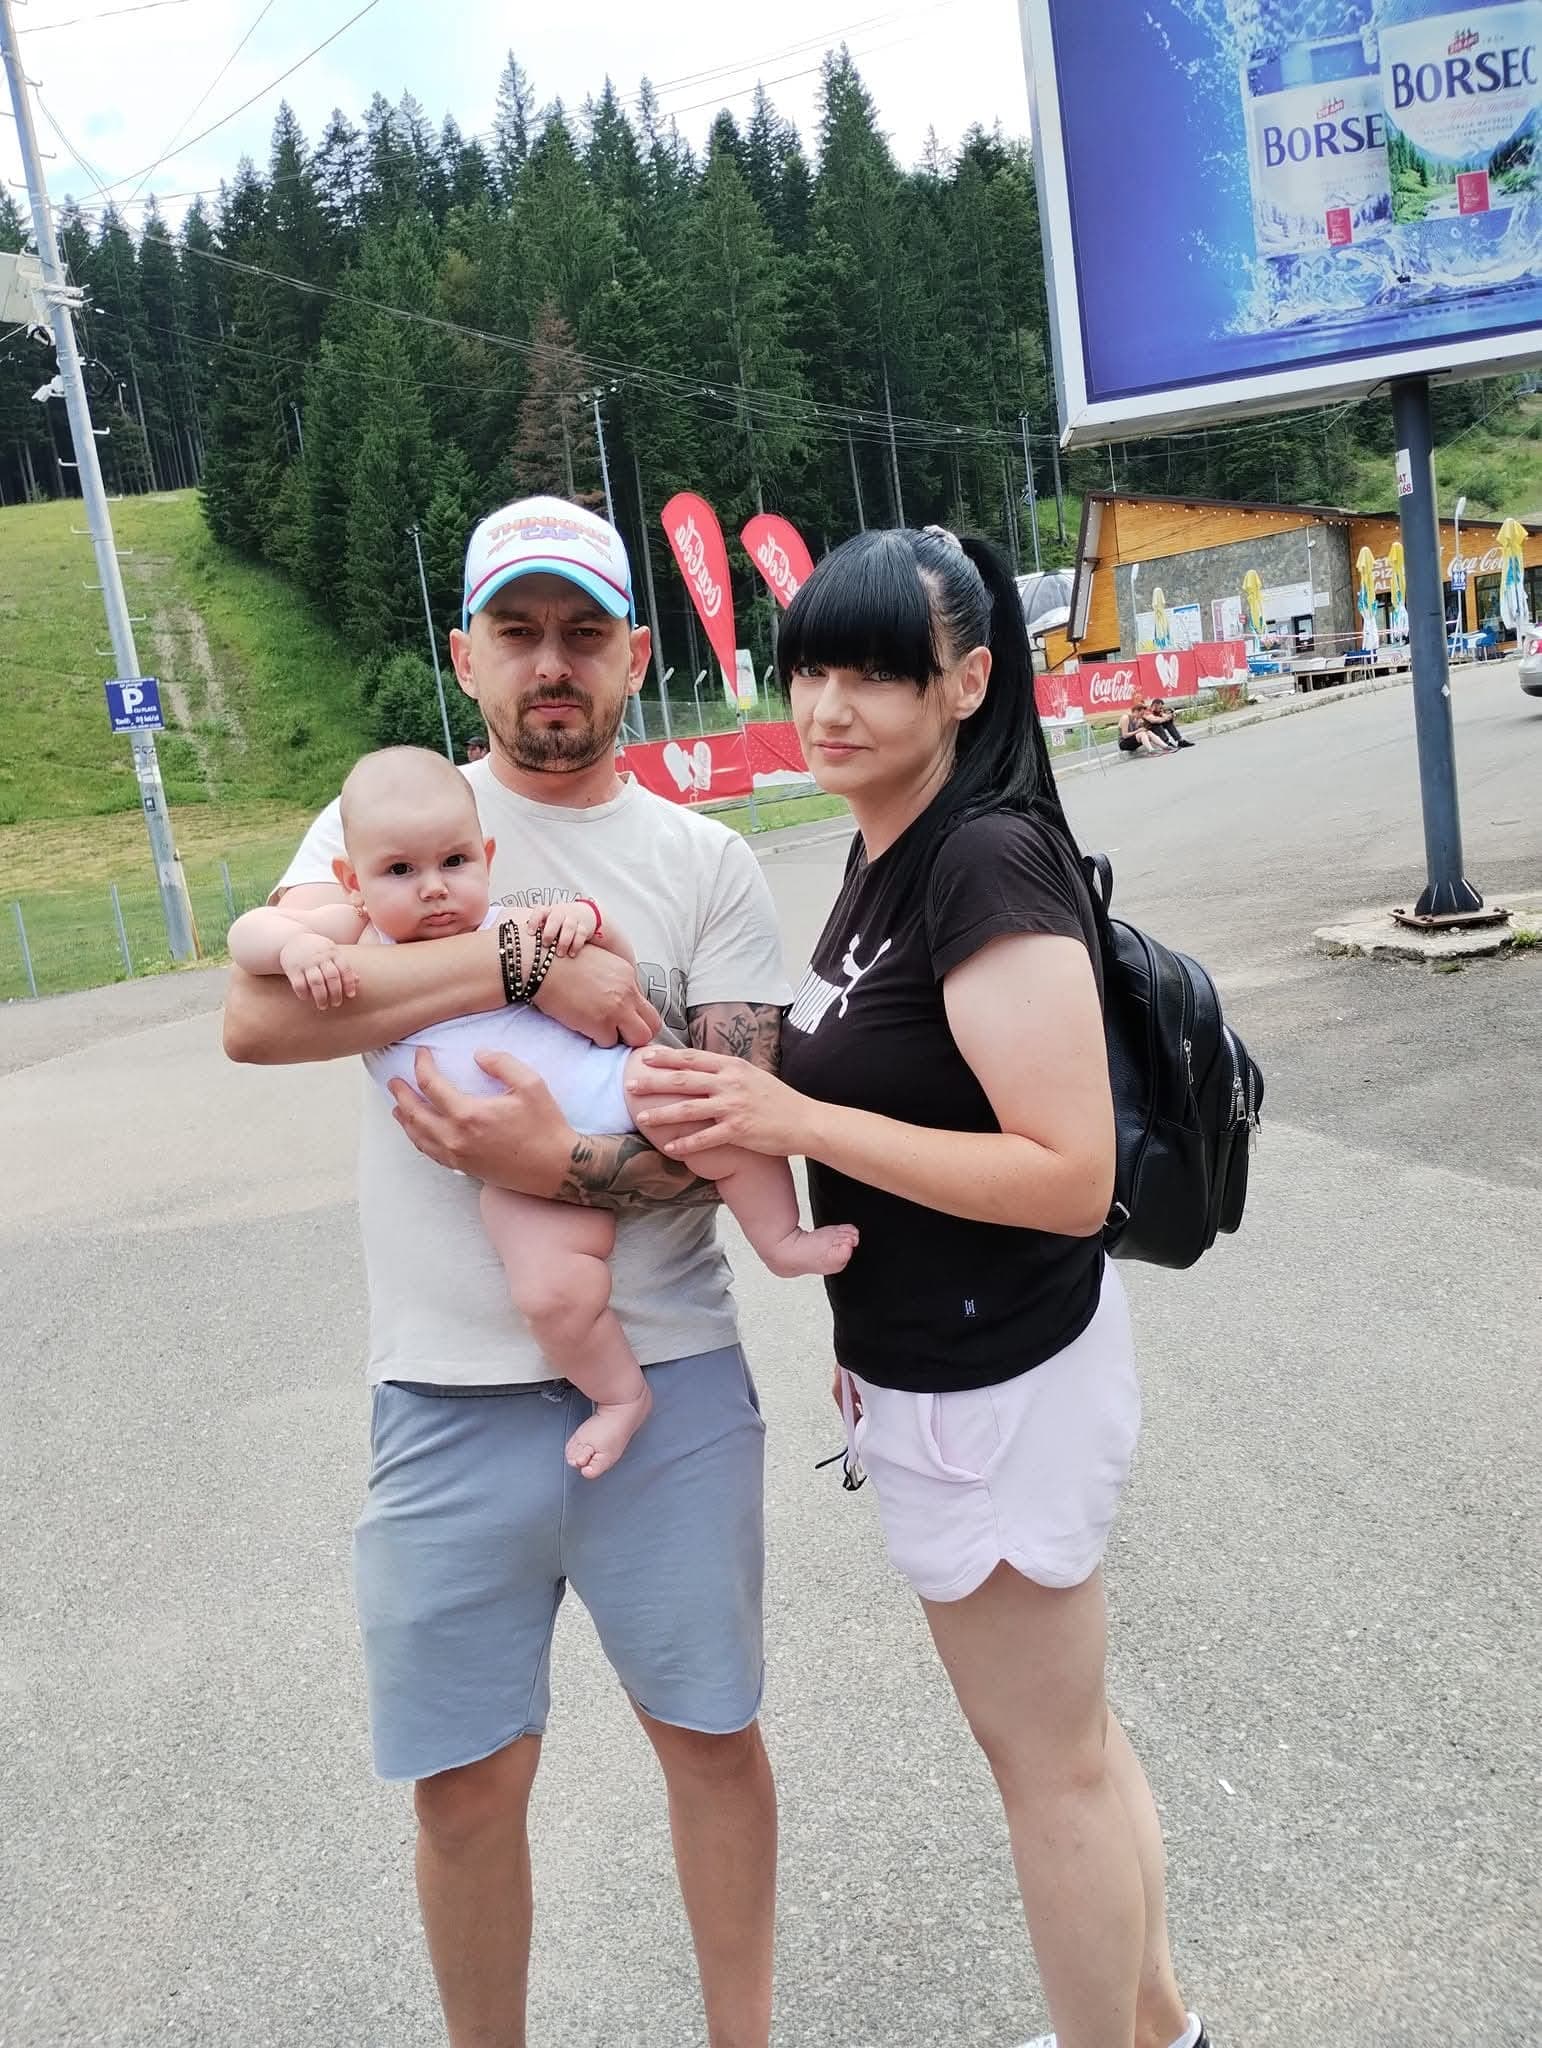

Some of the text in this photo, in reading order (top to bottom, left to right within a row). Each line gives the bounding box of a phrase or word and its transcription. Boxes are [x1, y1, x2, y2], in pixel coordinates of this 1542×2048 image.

[1391, 45, 1539, 109] BORSEC
[1263, 113, 1386, 168] BORSE
[121, 687, 144, 714] P
[1089, 669, 1135, 705] Coca-Cola
[490, 887, 595, 908] RIGIN
